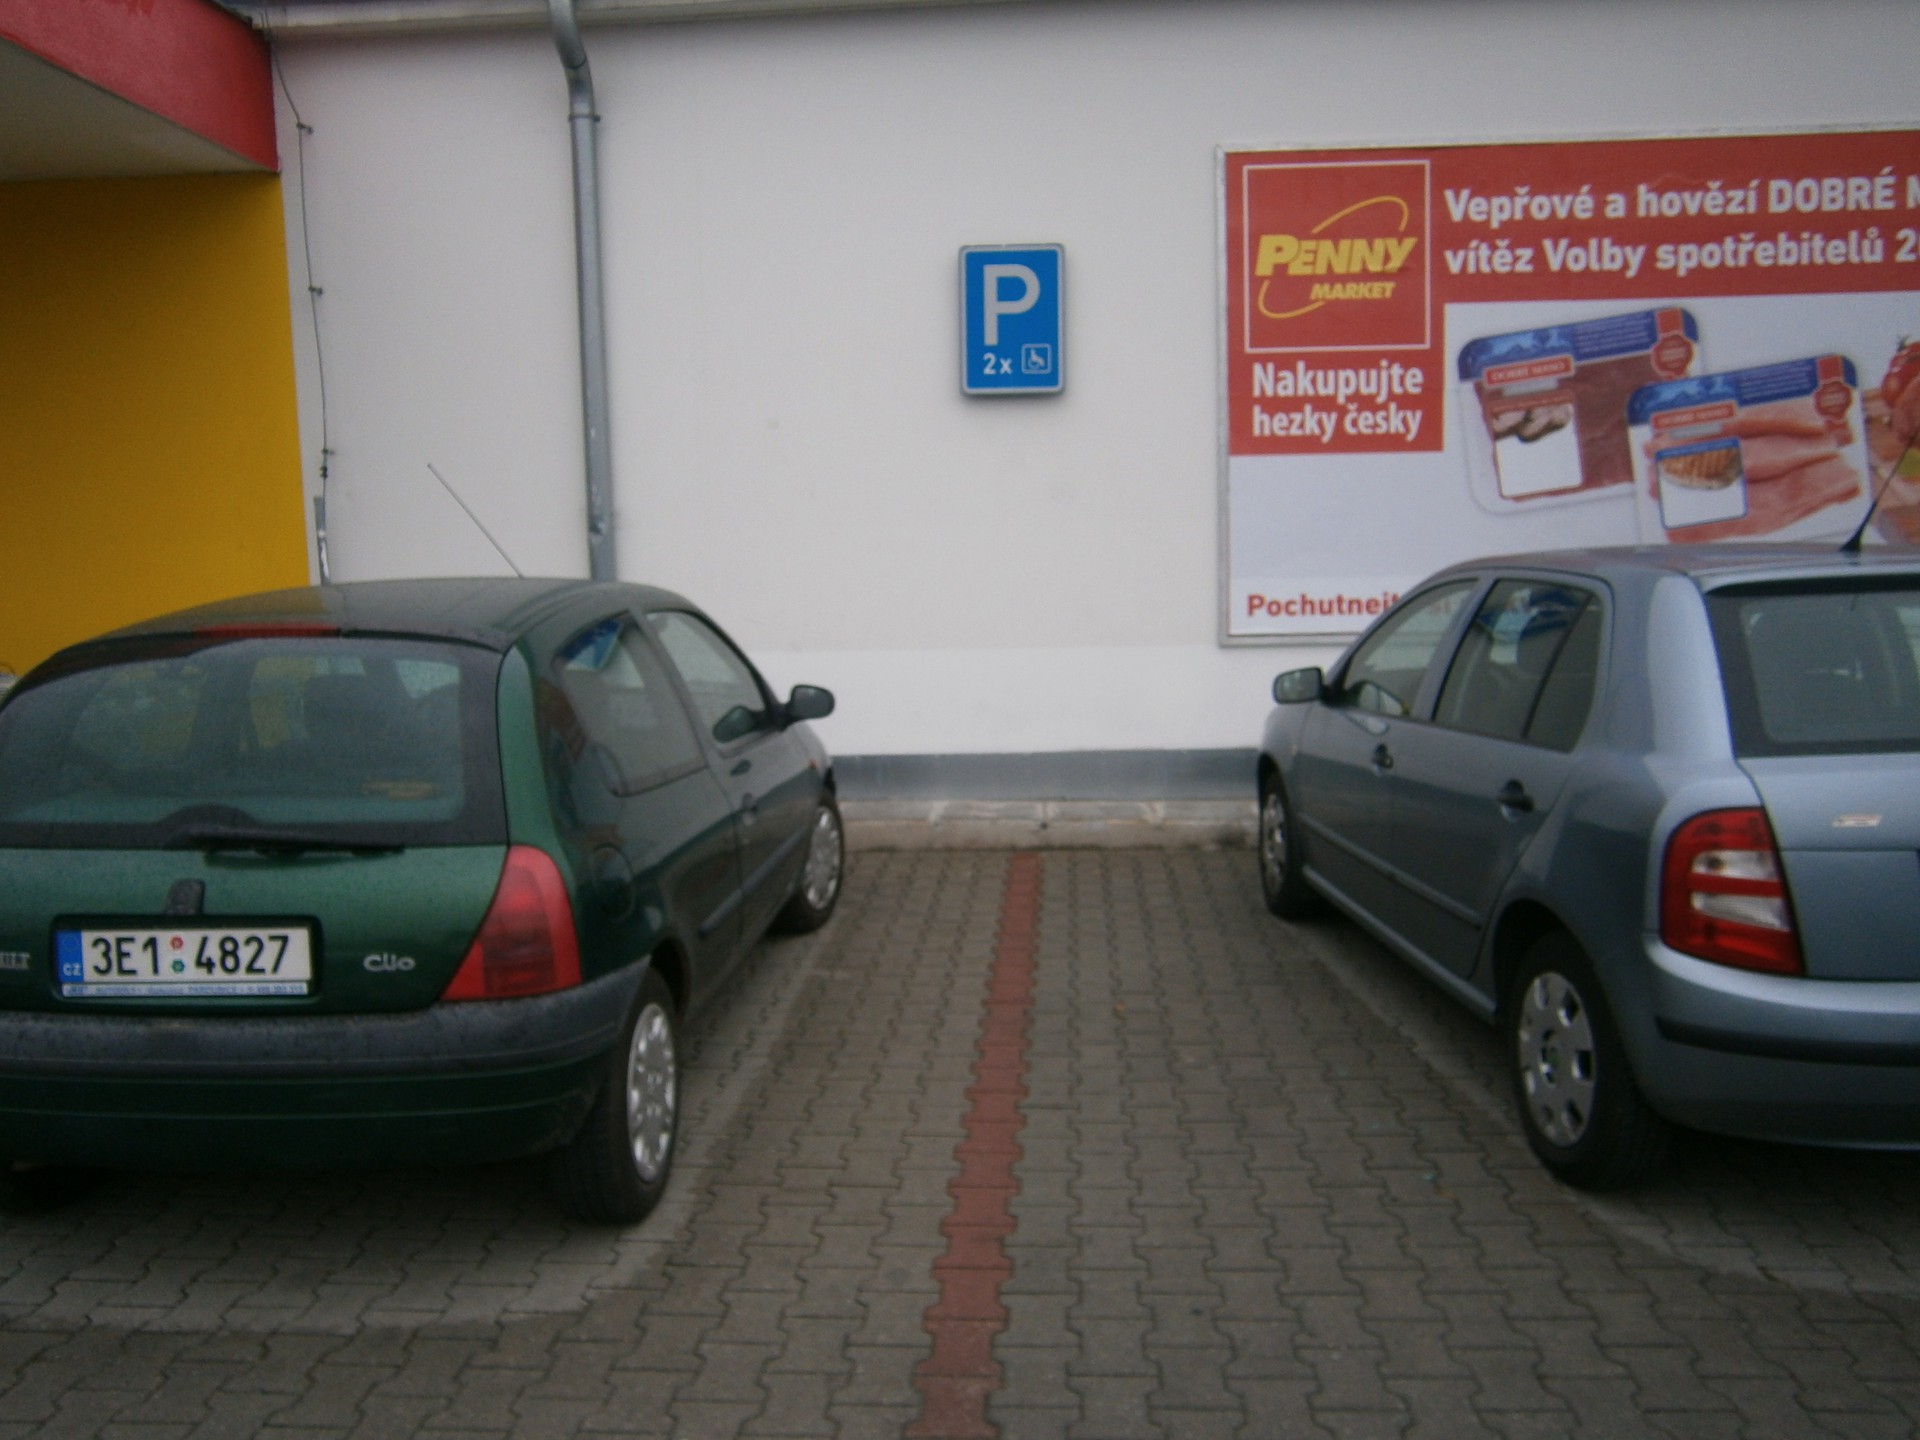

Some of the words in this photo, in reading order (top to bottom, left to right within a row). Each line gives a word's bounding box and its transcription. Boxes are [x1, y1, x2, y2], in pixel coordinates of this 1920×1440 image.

[1443, 183, 1594, 229] Vepřové
[1604, 192, 1627, 219] a
[1636, 178, 1761, 218] hovězí
[1767, 165, 1897, 214] DOBRÉ
[1254, 233, 1418, 276] PENNY
[1444, 239, 1534, 275] vítěz
[1542, 236, 1647, 279] Volby
[1655, 226, 1884, 278] spotřebitelů
[1894, 228, 1920, 263] 2
[983, 263, 1041, 346] P
[1310, 281, 1396, 300] MARKET
[1252, 358, 1424, 405] Nakupujte
[1252, 402, 1338, 444] hezky
[1343, 401, 1423, 442] česky
[92, 936, 159, 976] 3E1
[195, 935, 289, 975] 4827
[363, 952, 416, 972] Clio
